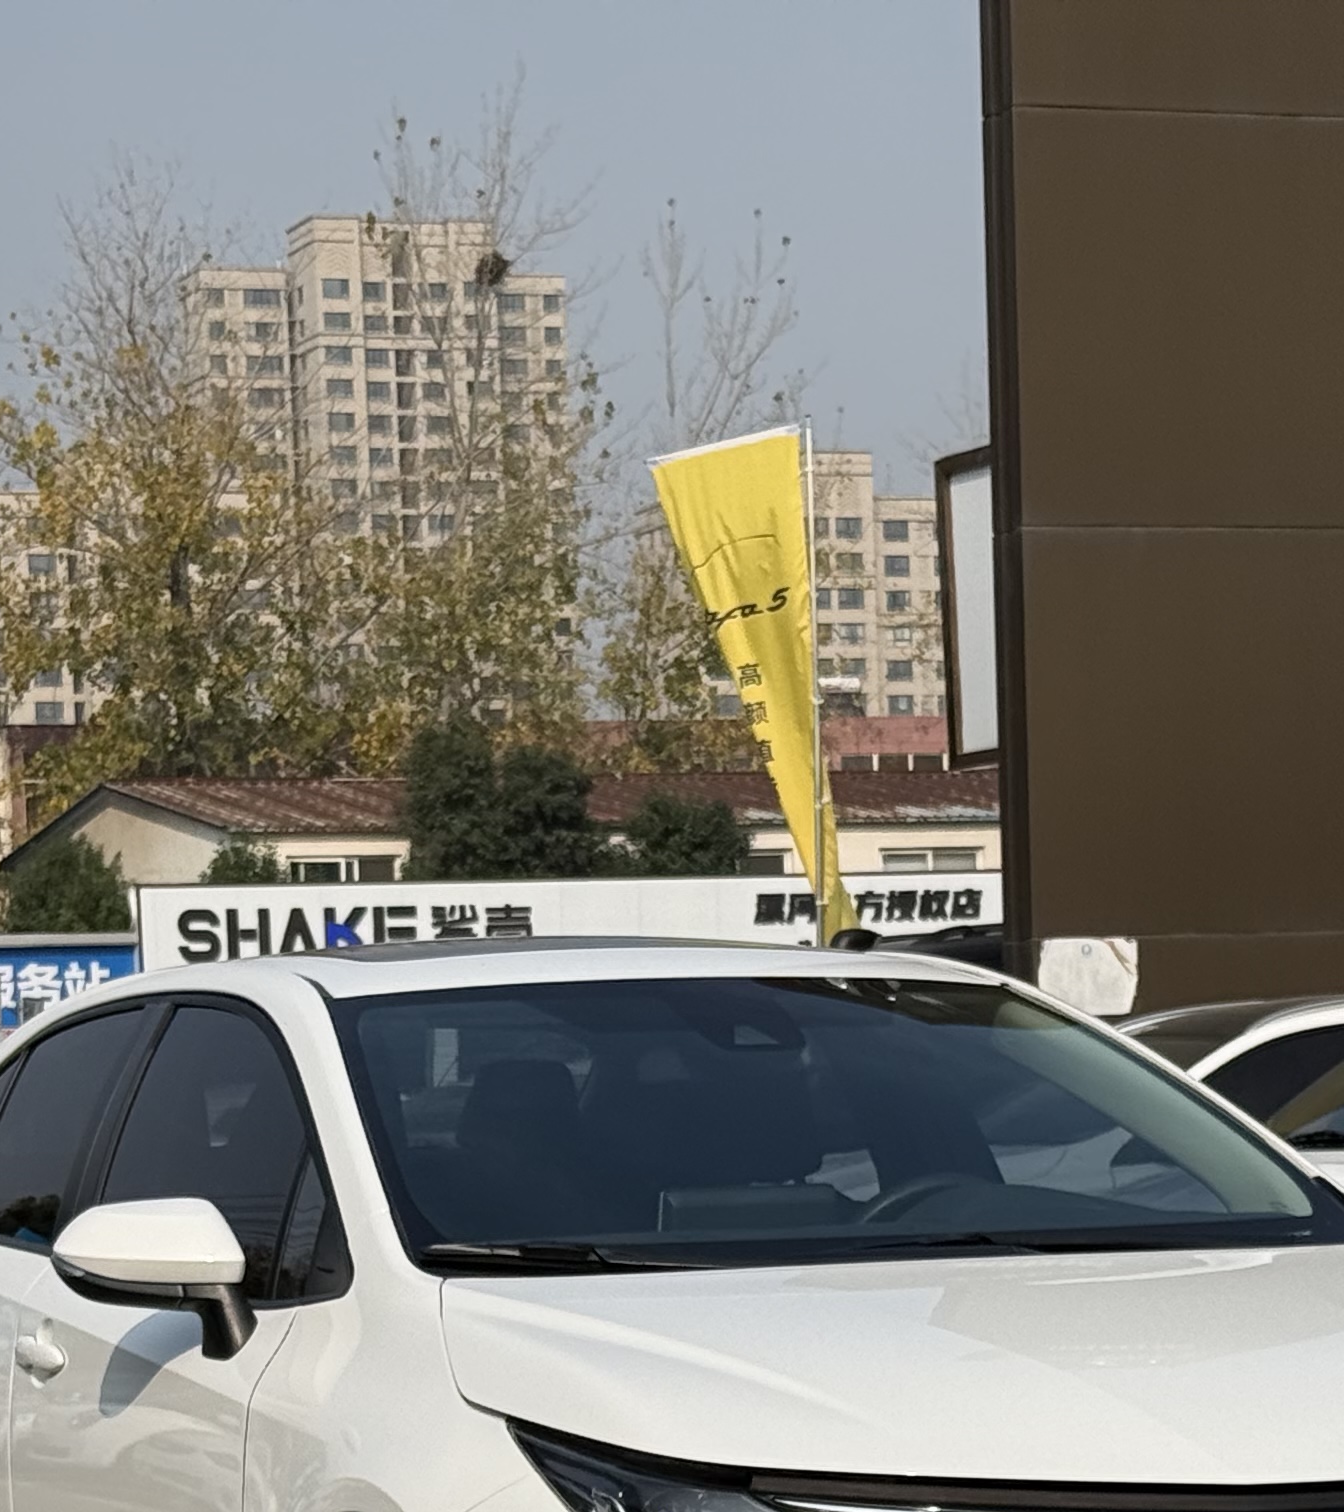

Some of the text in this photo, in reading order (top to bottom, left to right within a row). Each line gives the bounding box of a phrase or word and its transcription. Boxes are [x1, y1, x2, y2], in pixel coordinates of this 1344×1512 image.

[754, 888, 983, 925] 漯河方授权店
[177, 905, 418, 964] SHAKE
